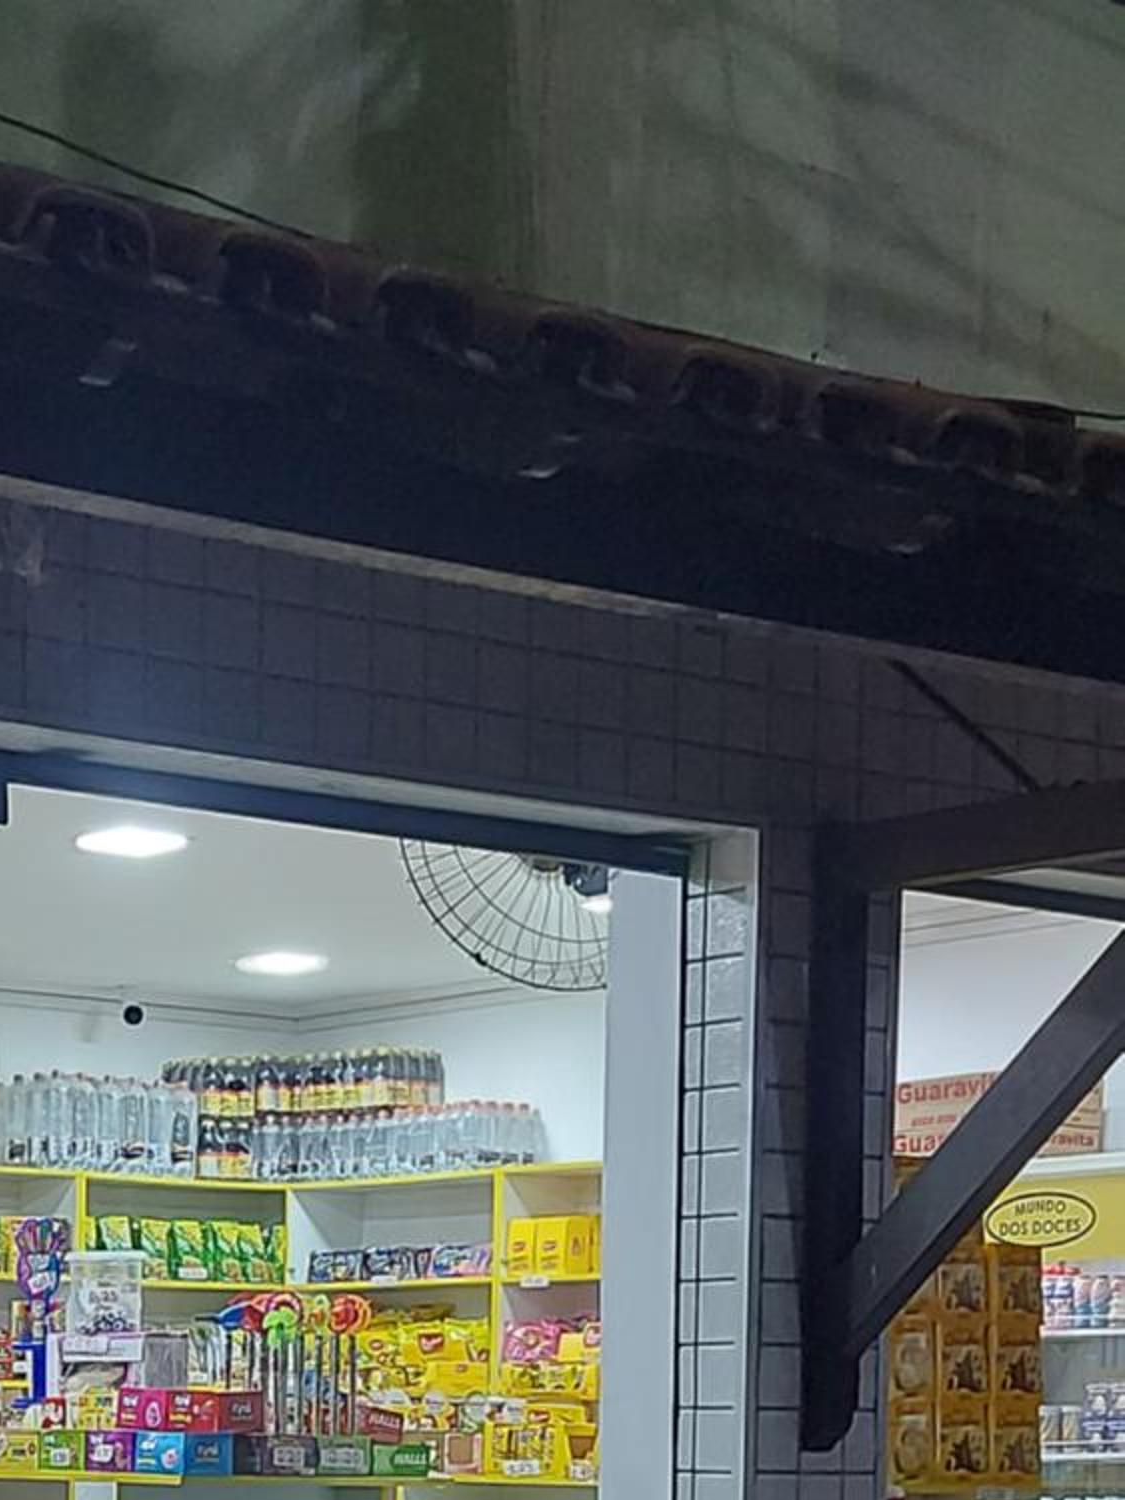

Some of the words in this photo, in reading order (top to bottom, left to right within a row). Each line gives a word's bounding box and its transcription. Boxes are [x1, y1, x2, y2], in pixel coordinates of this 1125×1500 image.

[1015, 1200, 1066, 1216] MUNDO
[999, 1221, 1026, 1237] DOS
[1032, 1217, 1082, 1234] DOCES
